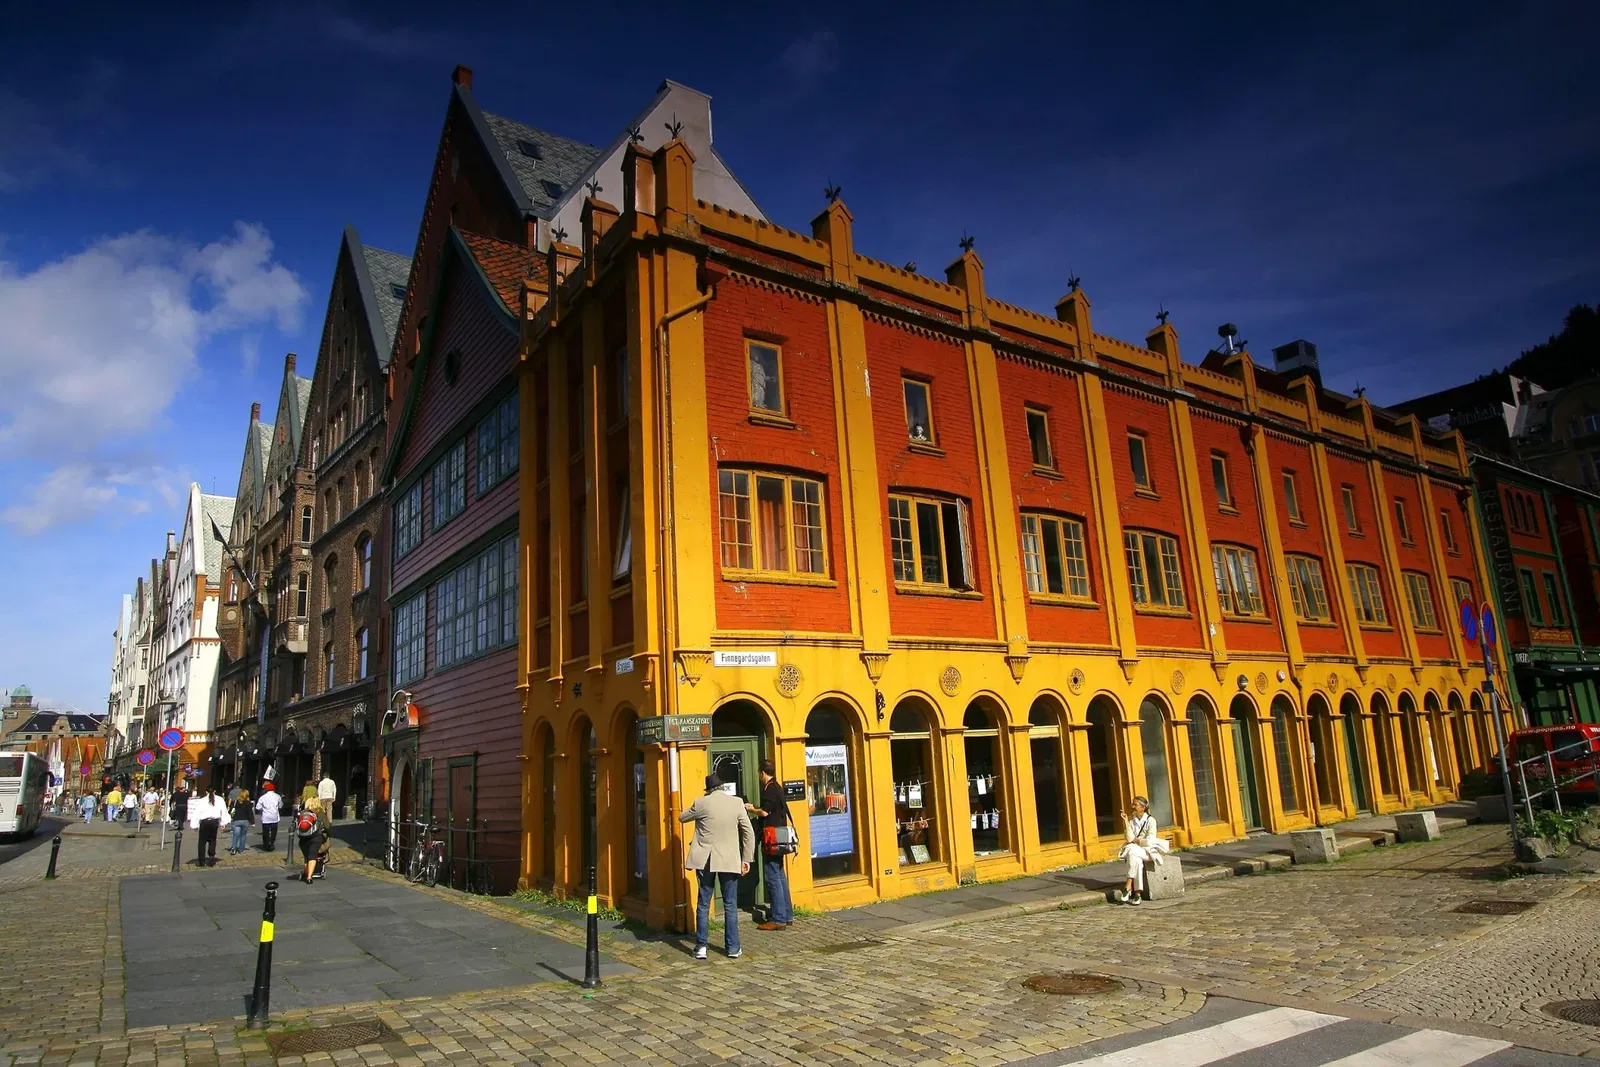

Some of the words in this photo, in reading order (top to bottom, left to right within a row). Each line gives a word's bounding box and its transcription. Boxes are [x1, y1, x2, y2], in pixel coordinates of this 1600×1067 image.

[1481, 488, 1521, 612] RESTAURANT
[721, 653, 771, 665] Finnegardsgaten
[681, 725, 700, 733] MUSEUM
[1516, 725, 1576, 735] www.peppes.no
